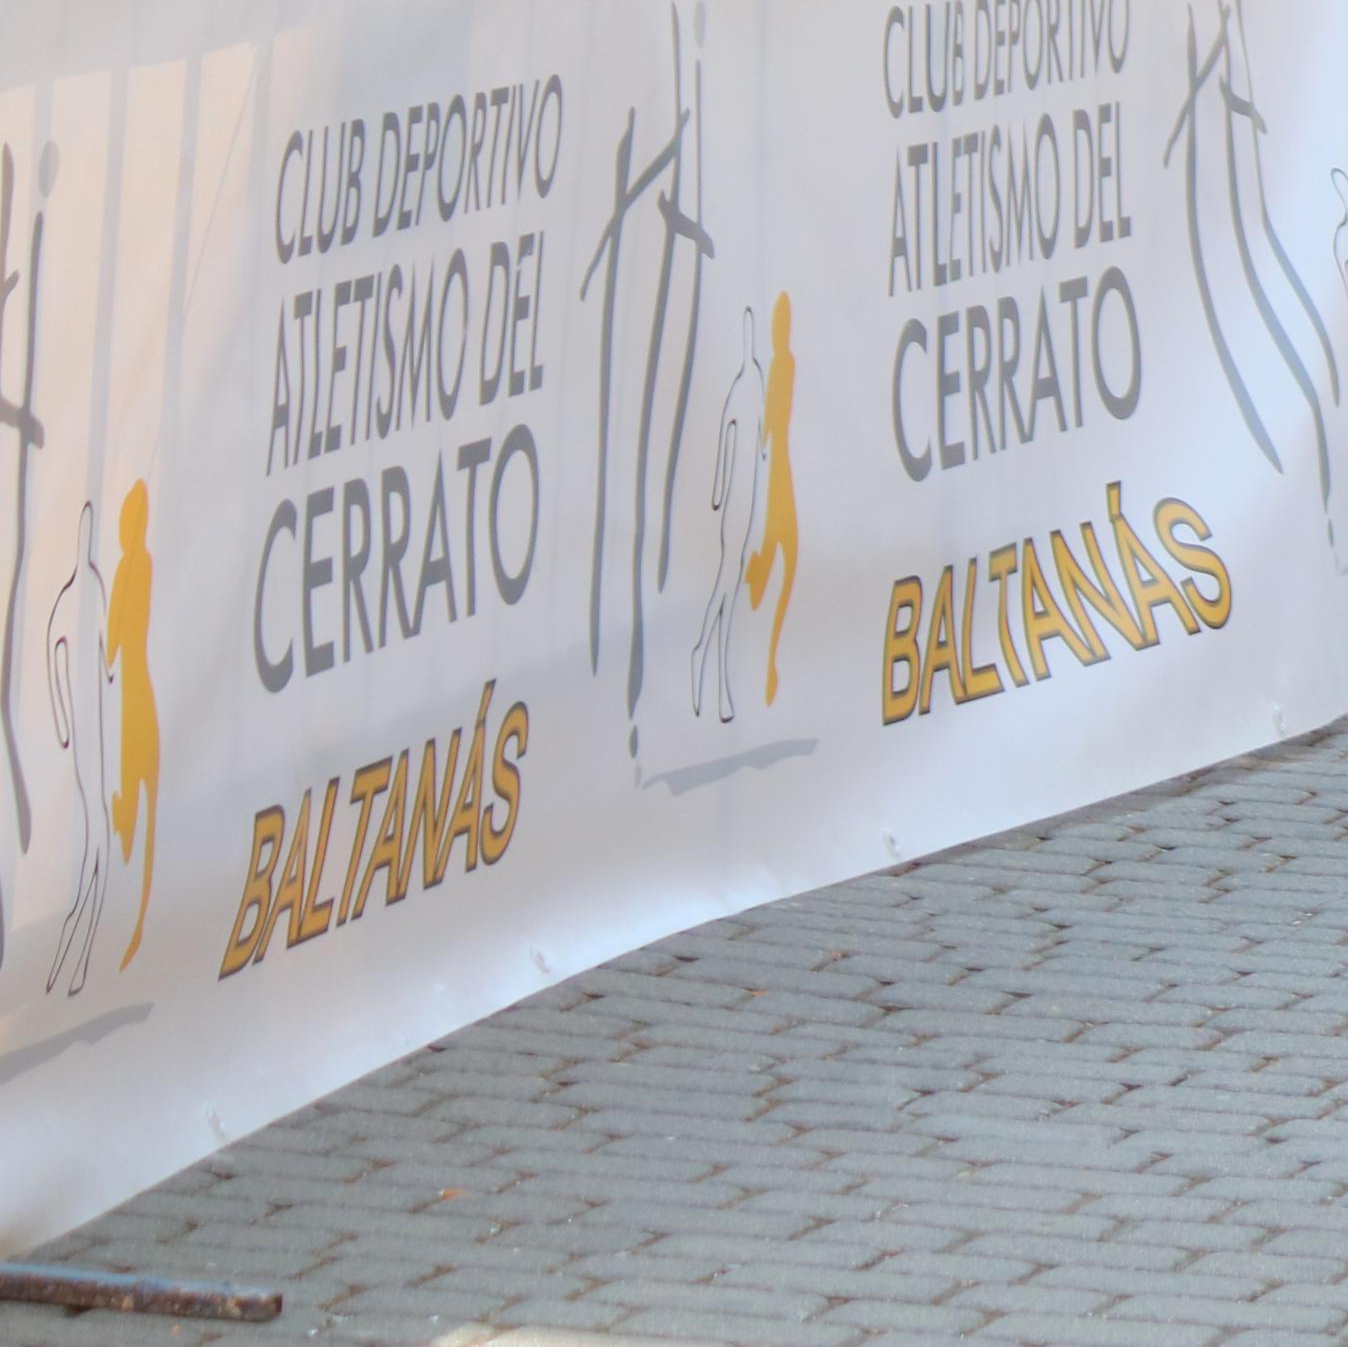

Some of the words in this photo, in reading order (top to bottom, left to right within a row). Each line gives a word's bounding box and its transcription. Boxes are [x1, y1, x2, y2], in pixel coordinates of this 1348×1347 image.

[275, 118, 366, 264] CLUB
[372, 74, 563, 222] DEPORTIVO
[888, 112, 1061, 297] ATLETISMO
[1072, 100, 1132, 250] DEL
[266, 247, 469, 477] ATLETISMO
[479, 230, 545, 407] DEL
[892, 265, 1143, 483] CERRATO
[253, 423, 540, 694] CERRATO
[882, 480, 1233, 727] BALTANÁS
[217, 678, 530, 982] BALTANÁS
